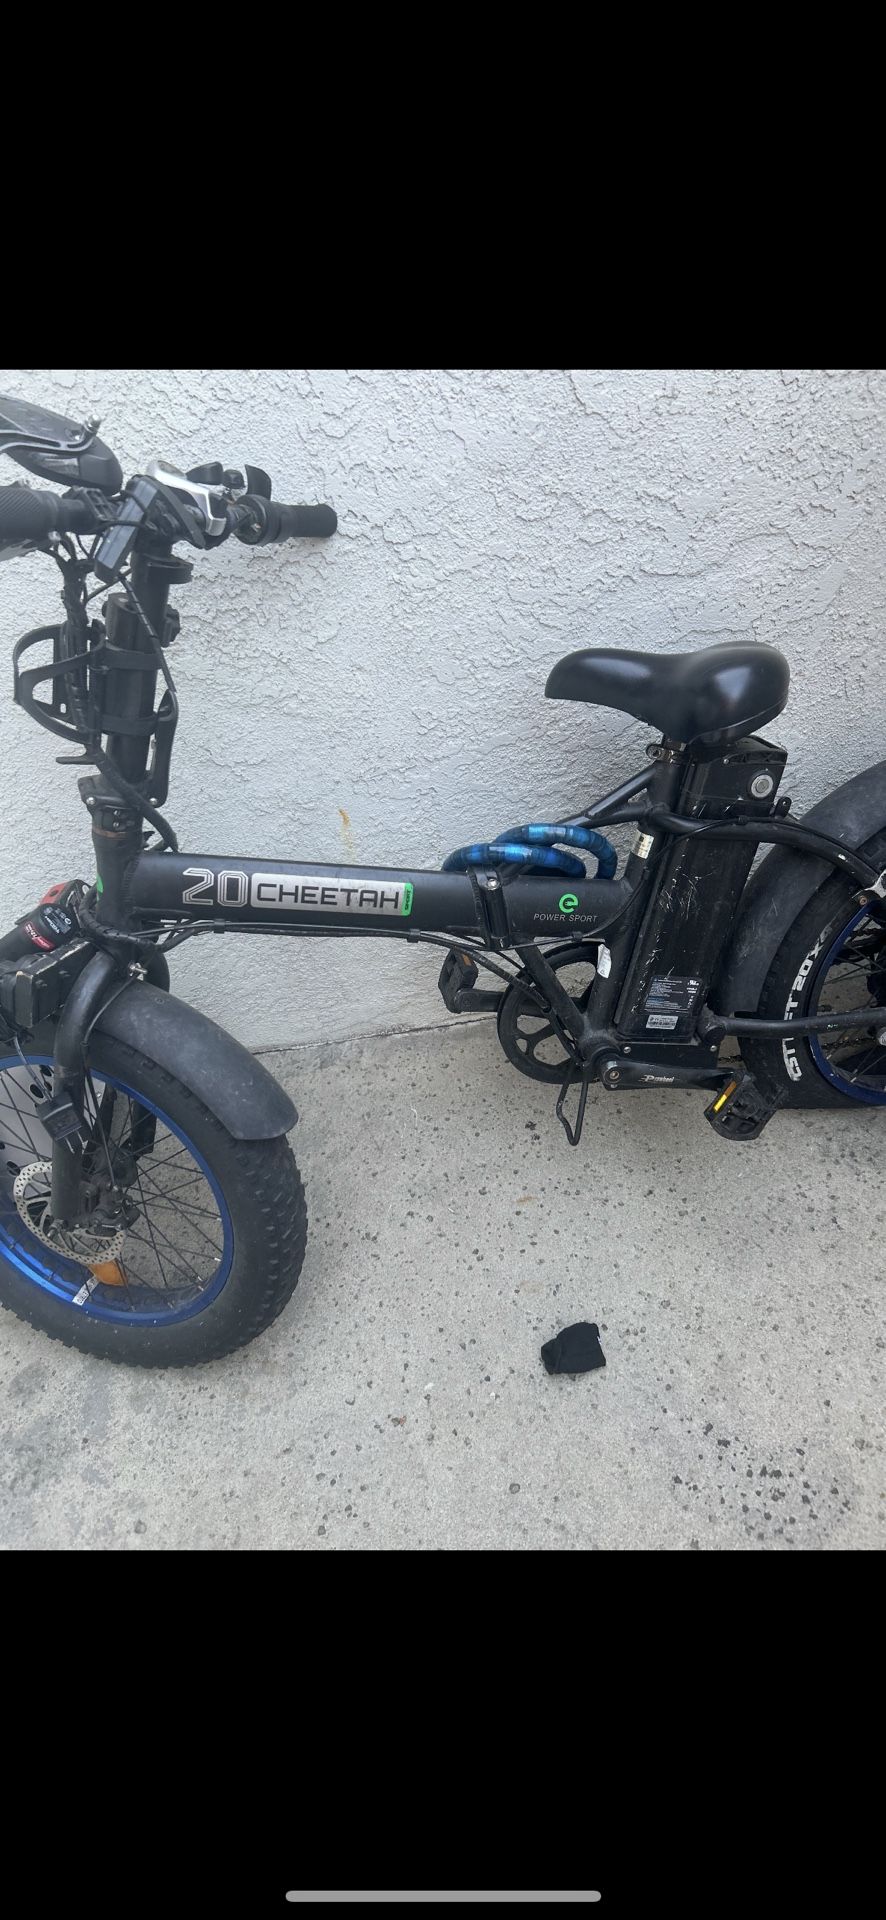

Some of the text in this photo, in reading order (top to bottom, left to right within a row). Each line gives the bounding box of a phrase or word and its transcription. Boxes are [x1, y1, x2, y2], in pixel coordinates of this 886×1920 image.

[182, 867, 400, 909] 20 CHEETAH
[533, 913, 598, 922] POWER SPORT
